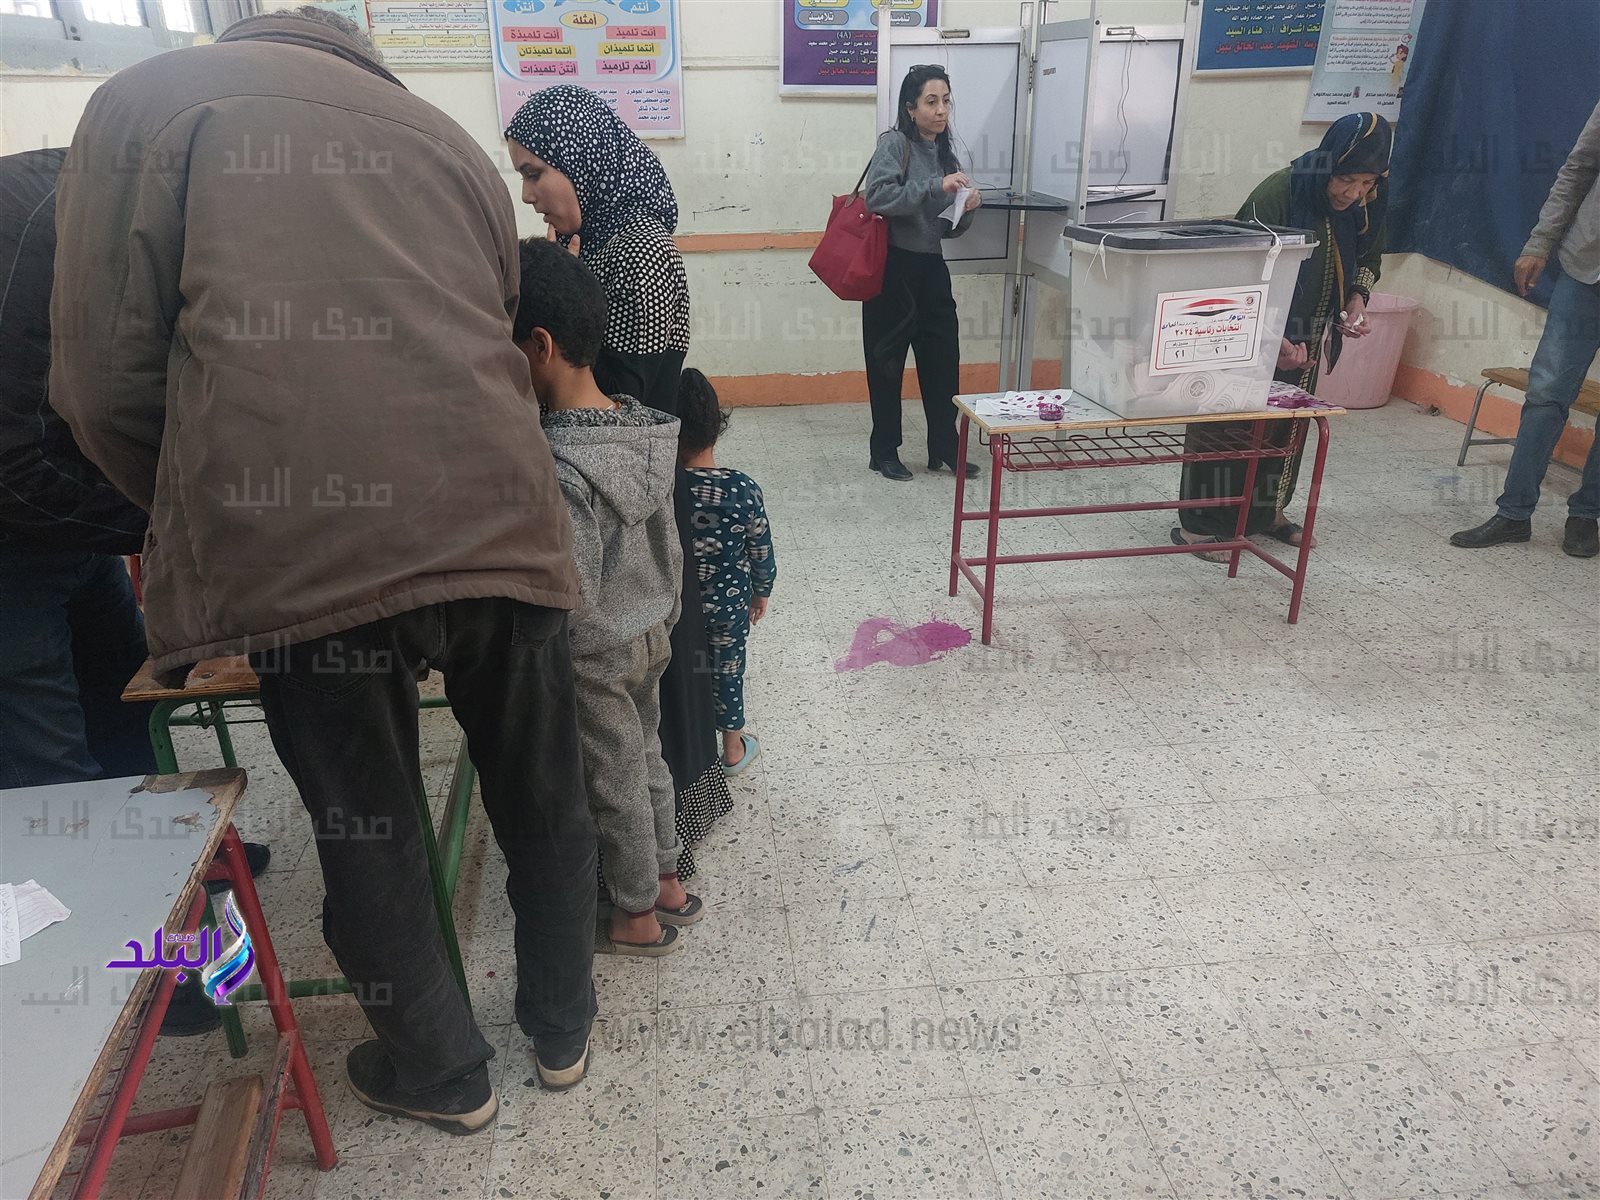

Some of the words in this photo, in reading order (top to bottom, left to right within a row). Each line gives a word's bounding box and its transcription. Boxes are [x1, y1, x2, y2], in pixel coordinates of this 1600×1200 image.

[572, 14, 598, 26] أمثلة
[511, 29, 541, 41] تلميذة
[616, 27, 638, 39] تلميذ
[836, 31, 852, 40] (4A)
[1225, 26, 1246, 38] السيد
[519, 46, 552, 57] تلميذتان
[555, 46, 572, 55] أنتما
[603, 43, 634, 54] تلميذان
[637, 42, 655, 53] أنتما
[520, 64, 556, 75] تلميذات
[602, 61, 630, 73] تلاميذ
[633, 60, 651, 73] أنتم
[1174, 327, 1193, 337] ٢٠٢٤
[1194, 325, 1215, 337] رئاسية
[1216, 323, 1242, 335] انتخابات
